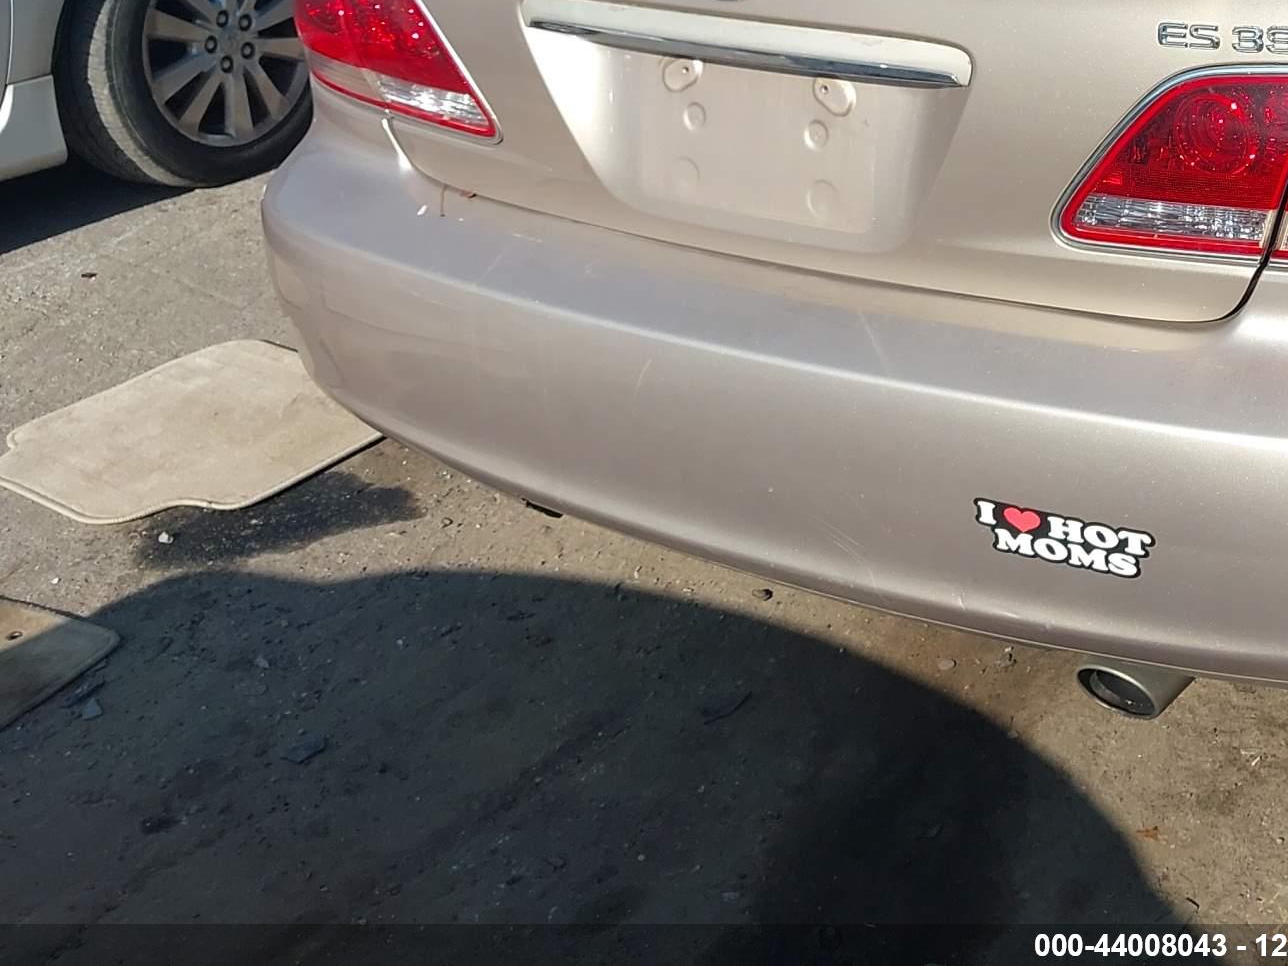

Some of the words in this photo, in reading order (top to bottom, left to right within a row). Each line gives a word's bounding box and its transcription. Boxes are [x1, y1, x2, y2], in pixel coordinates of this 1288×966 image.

[1157, 22, 1221, 50] ES
[976, 500, 998, 526] I
[1046, 515, 1152, 557] HOT
[993, 528, 1139, 577] MOMS
